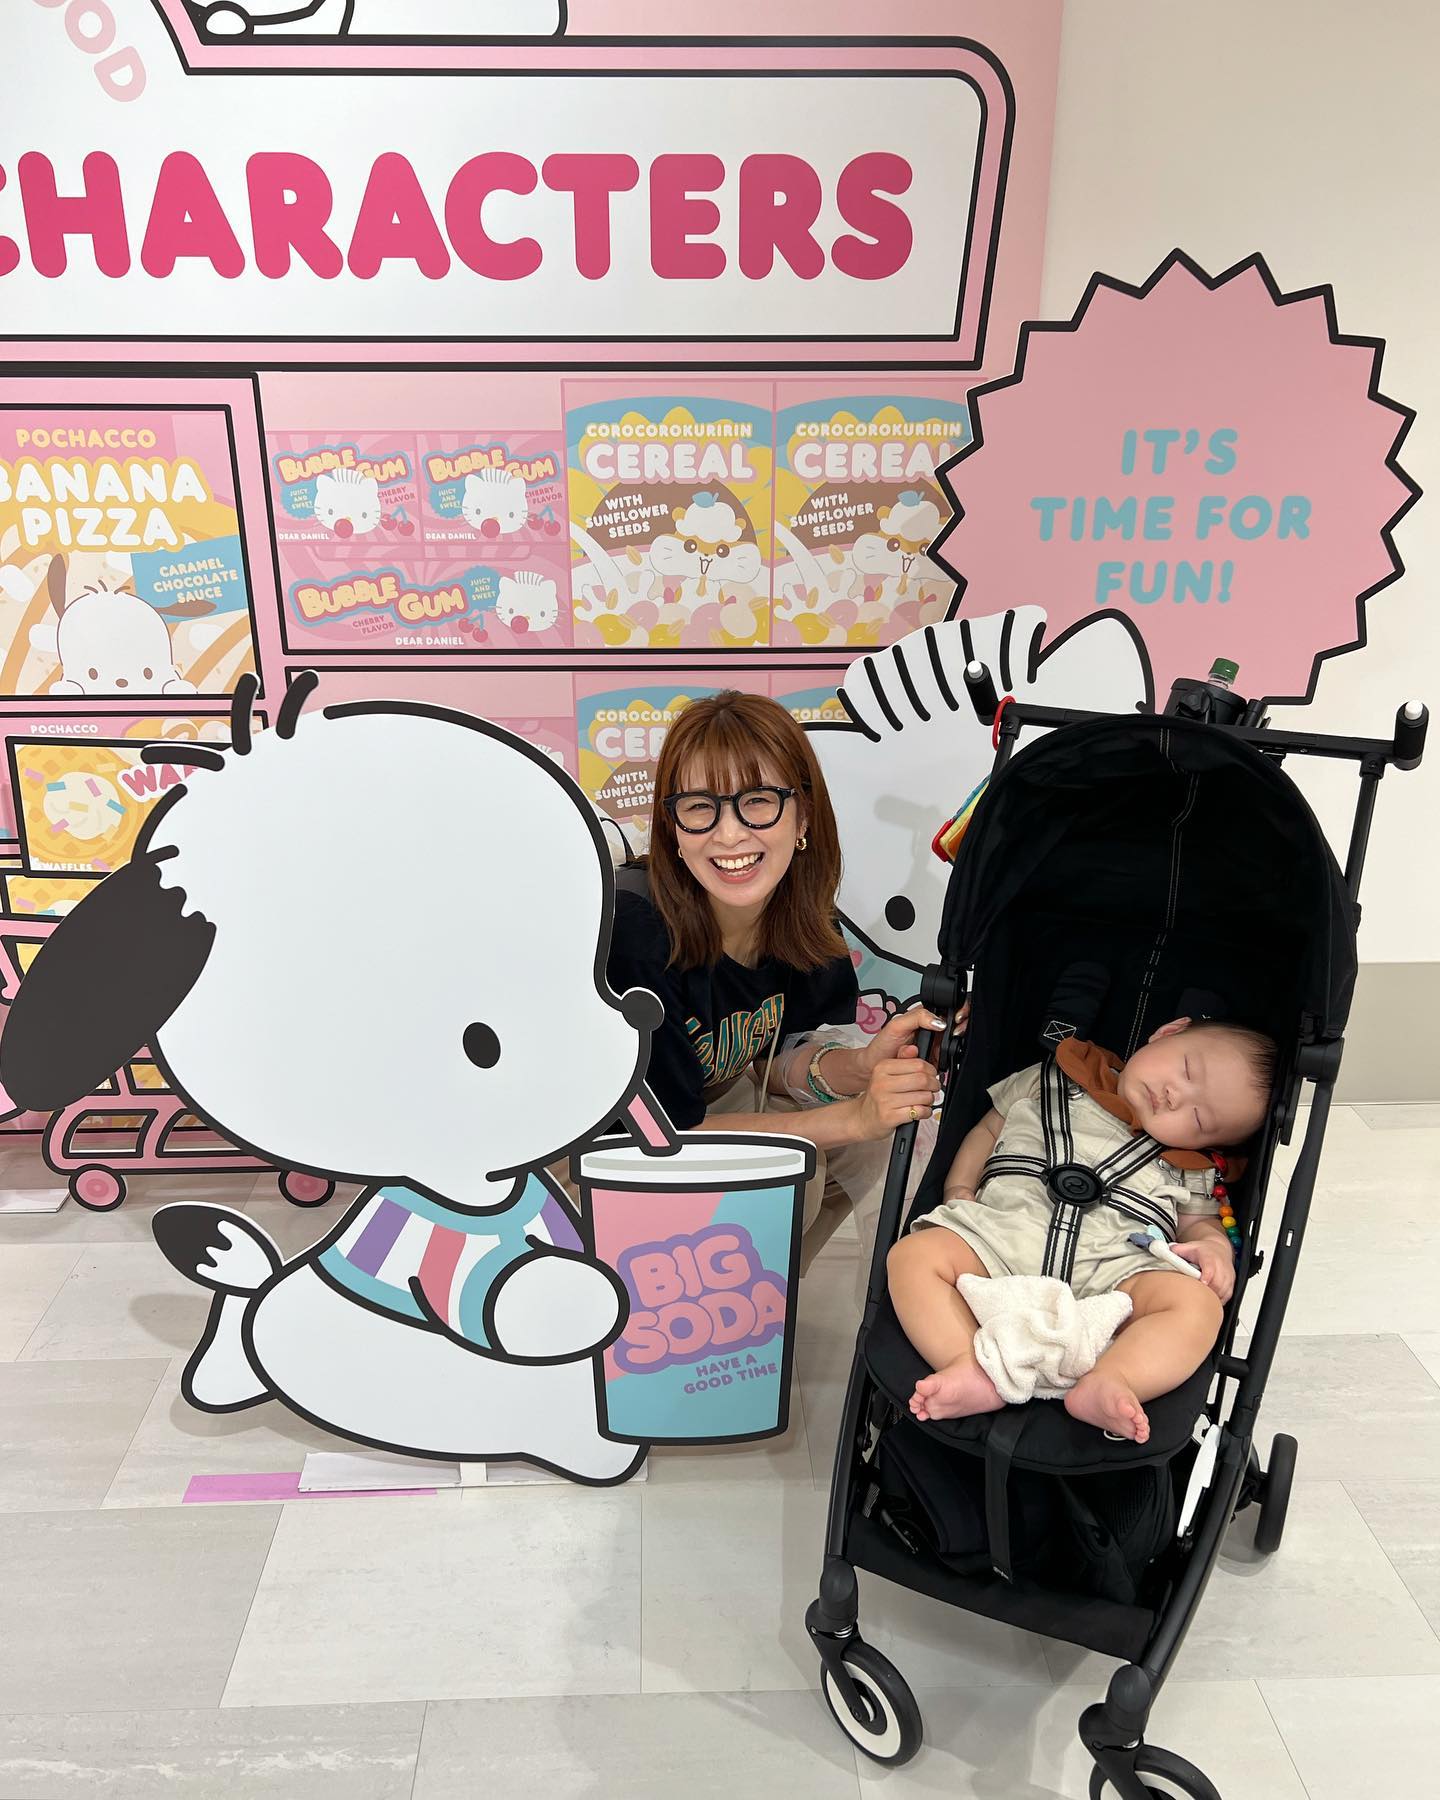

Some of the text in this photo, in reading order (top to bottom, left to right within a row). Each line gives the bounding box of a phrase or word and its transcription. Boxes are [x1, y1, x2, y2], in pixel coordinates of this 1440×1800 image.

[33, 0, 147, 103] OD
[0, 151, 914, 281] HARACTERS
[15, 428, 157, 448] POCHACCO
[585, 423, 753, 438] COROCOROKURIRIN
[795, 422, 962, 437] COROCOROKURIRIN
[585, 443, 753, 480] CEREAL
[289, 487, 309, 498] JUICY
[293, 494, 309, 503] AND
[377, 486, 408, 499] CHERRY
[385, 492, 416, 505] FLAVOR
[438, 487, 457, 497] JUICY
[441, 494, 457, 503] AND
[524, 486, 555, 499] CHERRY
[532, 492, 563, 505] FLAVOR
[604, 493, 644, 511] WITH
[810, 492, 849, 510] WITH
[584, 503, 670, 529] SUNFLOWER
[789, 502, 875, 528] SUNFLOWER
[1029, 494, 1312, 542] TIME FOR
[21, 507, 179, 546] PIZZA
[608, 521, 651, 539] SEEDS
[812, 520, 855, 538] SEEDS
[278, 532, 330, 541] DEAR DANIEL
[425, 532, 477, 541] DEAR DANIEL
[159, 557, 225, 578] CARAMEL
[153, 568, 239, 593] CHOCOLATE
[469, 577, 492, 586] JUICY
[473, 584, 490, 593] AND
[1094, 559, 1235, 605] FUN!
[176, 586, 223, 604] SAUCE
[297, 576, 465, 620] BUBBLE GUM
[471, 590, 497, 601] SWEET
[352, 614, 386, 628] CHERRY
[362, 621, 395, 635] FLAVOR
[395, 636, 465, 646] DEAR DANIEL
[30, 724, 99, 734] POCHACCO
[612, 770, 649, 785] WITH
[615, 793, 655, 809] SEEDS
[629, 1234, 752, 1308] BIG
[621, 1280, 787, 1364] SODA
[695, 1353, 758, 1378] HAVE A
[683, 1362, 779, 1395] GOOD TIME
